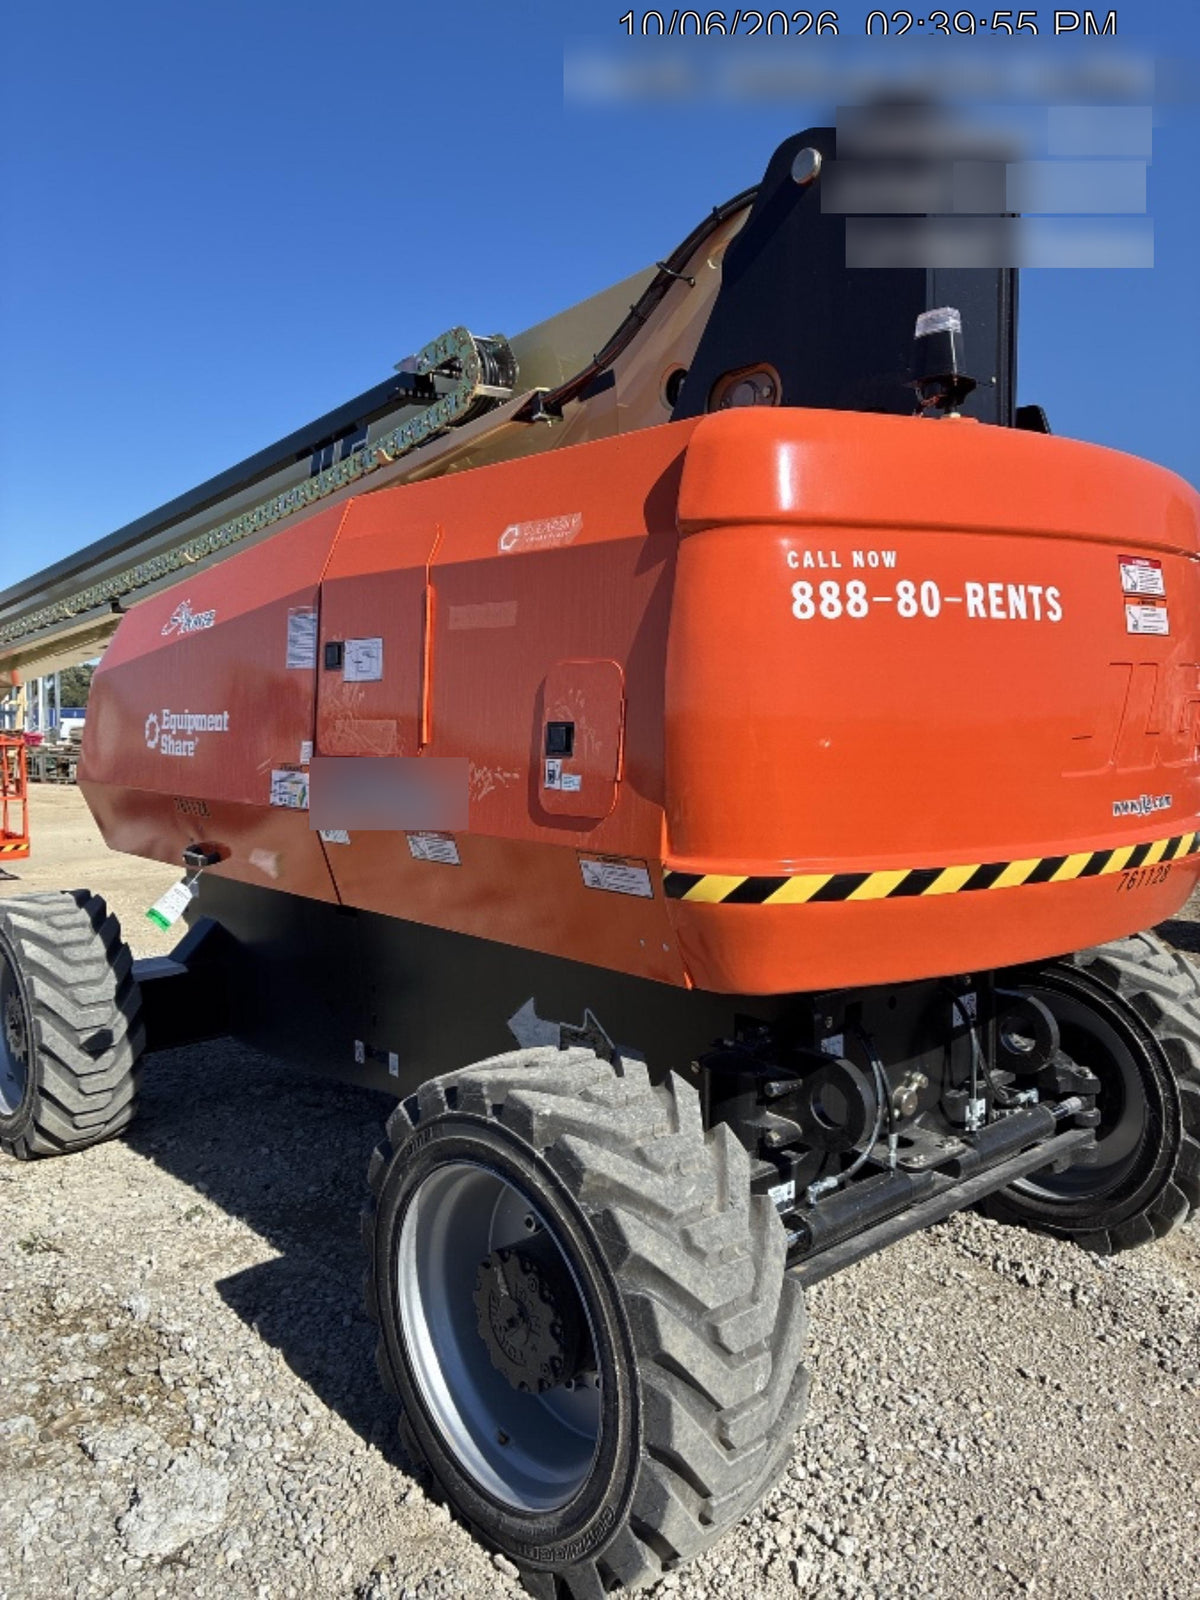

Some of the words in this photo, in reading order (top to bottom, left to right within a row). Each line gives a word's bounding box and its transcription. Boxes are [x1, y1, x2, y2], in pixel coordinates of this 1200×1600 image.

[787, 550, 842, 569] CALL
[852, 550, 897, 569] NOW
[791, 579, 1063, 622] 888-80-RENTS
[161, 708, 230, 735] Equipment
[161, 734, 195, 757] Share
[1115, 862, 1173, 893] 761128
